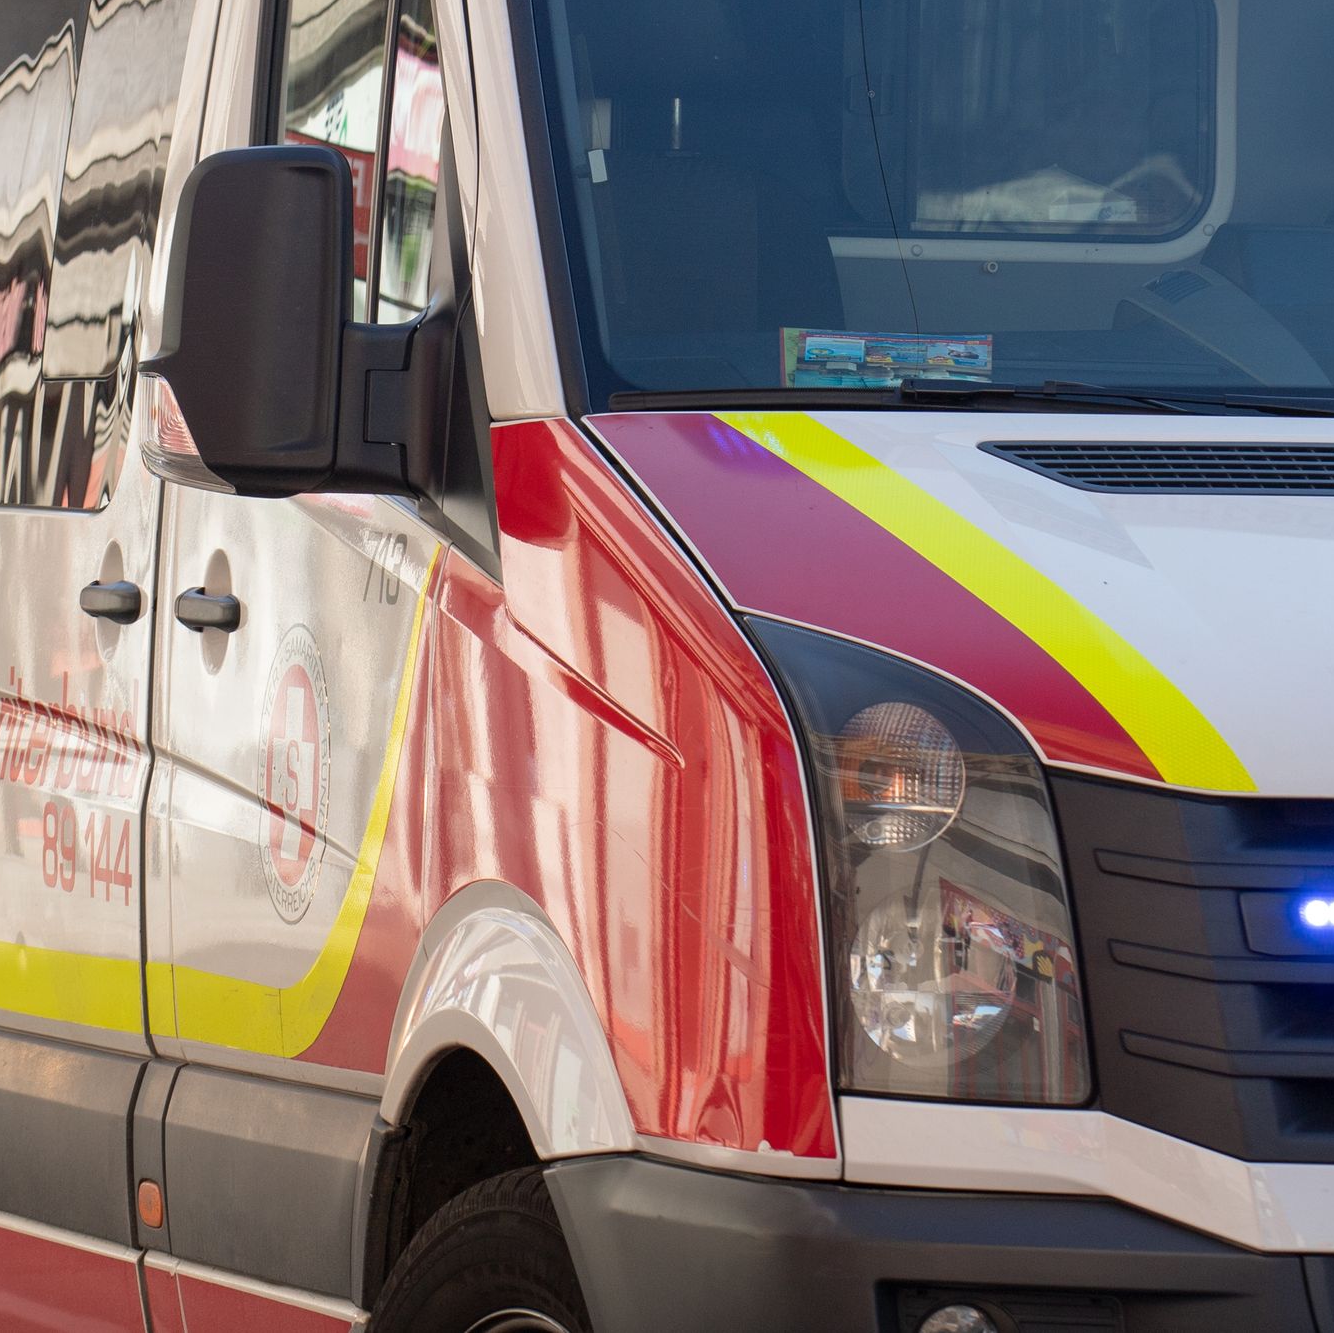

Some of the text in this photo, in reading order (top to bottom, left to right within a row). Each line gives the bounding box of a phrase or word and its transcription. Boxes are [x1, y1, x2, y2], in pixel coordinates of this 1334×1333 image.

[285, 738, 301, 813] S
[42, 801, 133, 906] 89 144
